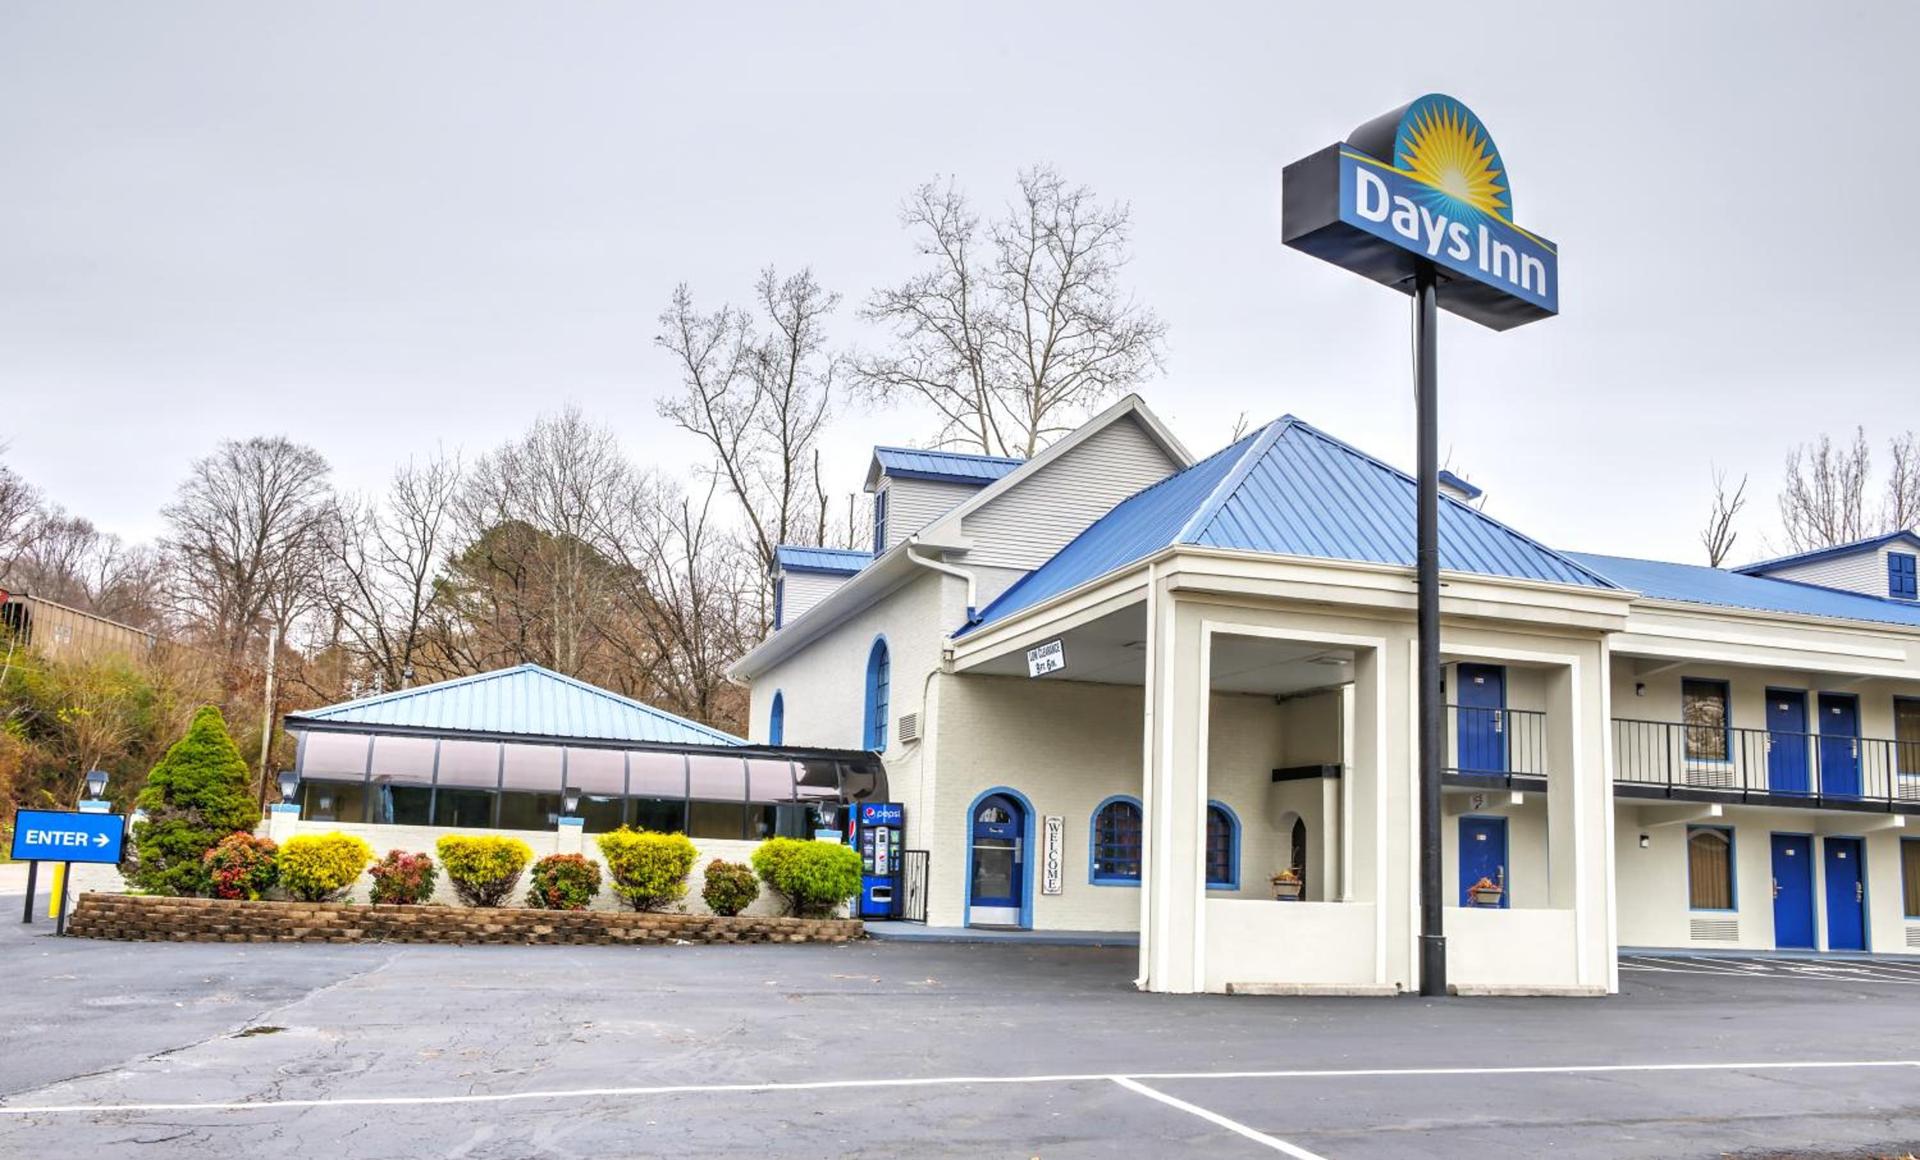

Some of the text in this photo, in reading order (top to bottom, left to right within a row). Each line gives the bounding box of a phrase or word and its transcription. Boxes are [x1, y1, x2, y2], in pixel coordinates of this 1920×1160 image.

[1356, 166, 1546, 297] Days Inn
[876, 810, 901, 819] pepsi
[25, 829, 89, 846] ENTER
[1047, 822, 1060, 889] WELCOME
